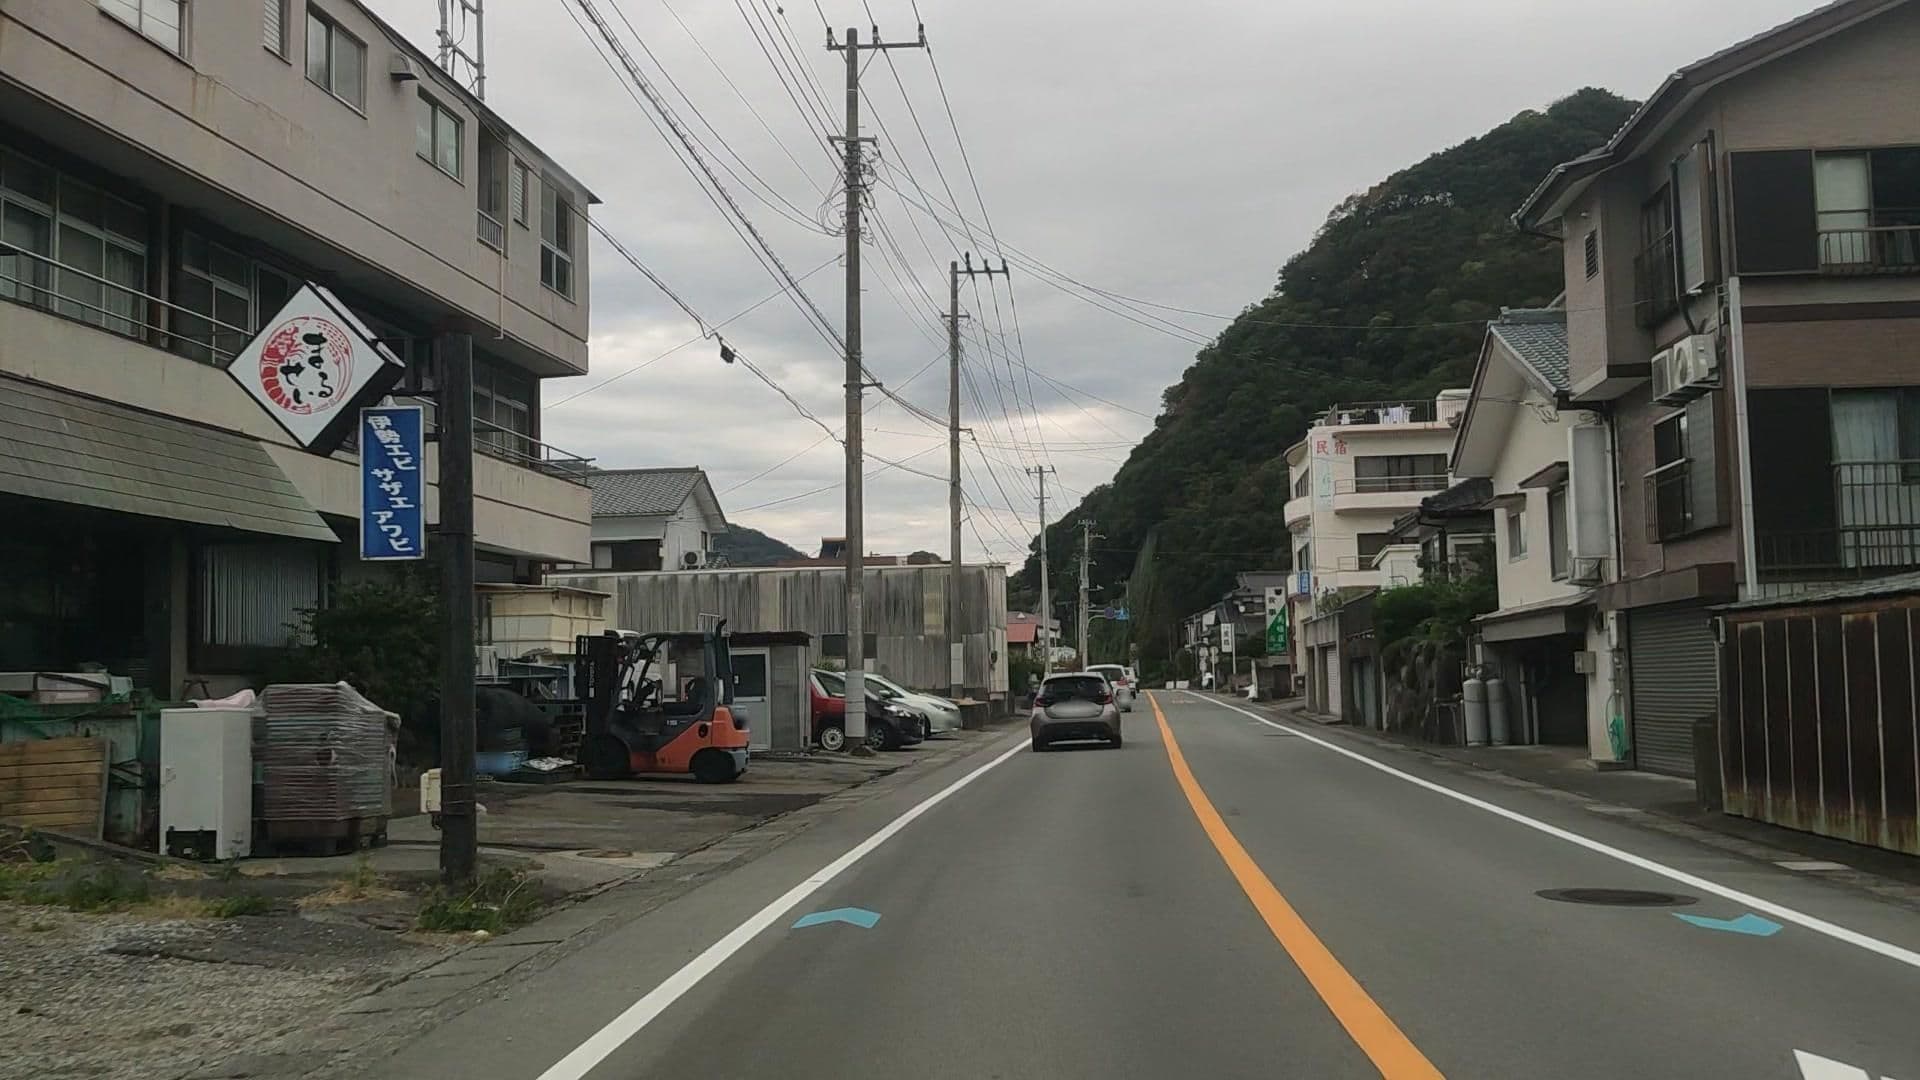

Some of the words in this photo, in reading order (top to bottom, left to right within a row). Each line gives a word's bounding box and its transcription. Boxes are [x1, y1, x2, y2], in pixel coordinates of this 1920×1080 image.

[367, 415, 417, 471] 伊勢エビ
[1316, 440, 1348, 455] 民宿
[370, 467, 416, 509] サザエ
[371, 510, 414, 552] アワビ
